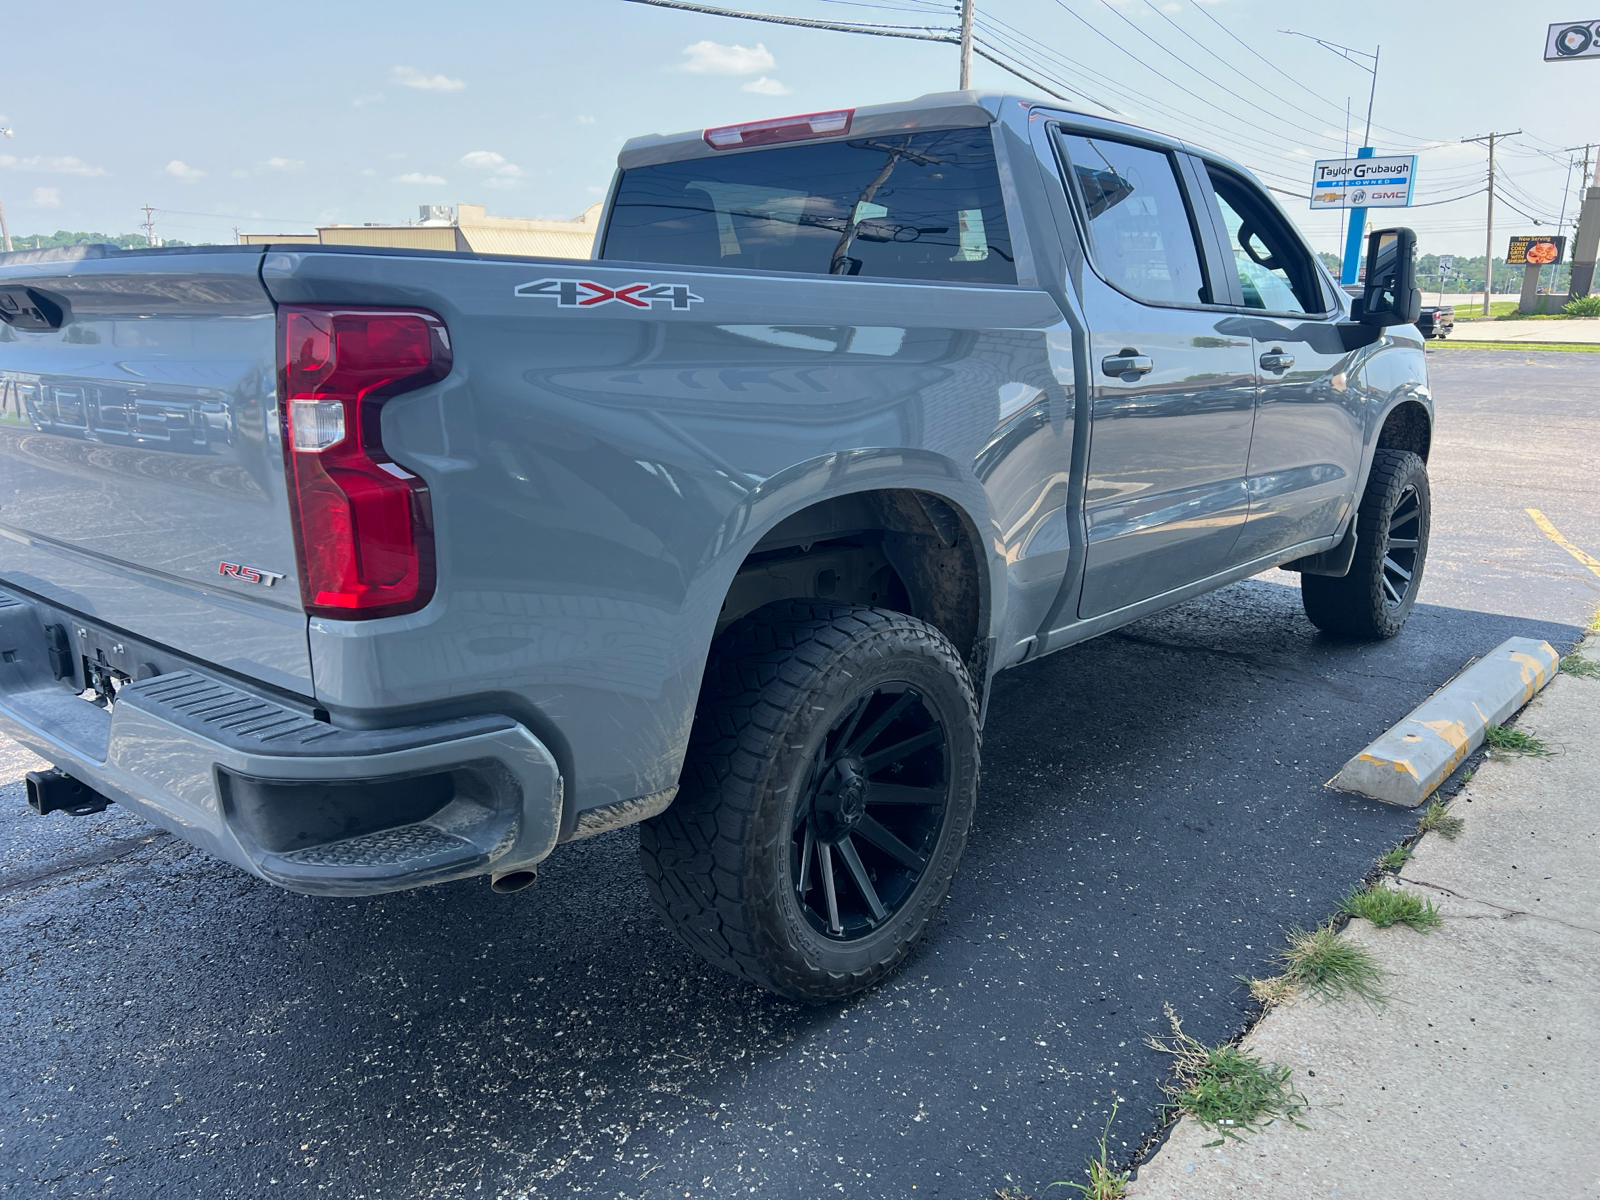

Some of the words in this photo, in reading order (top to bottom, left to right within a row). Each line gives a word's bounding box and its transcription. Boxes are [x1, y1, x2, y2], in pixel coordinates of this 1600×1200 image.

[1318, 164, 1352, 180] Taylor
[1354, 163, 1409, 178] Grubaugh
[1371, 191, 1406, 199] GMC
[219, 560, 286, 587] RST
